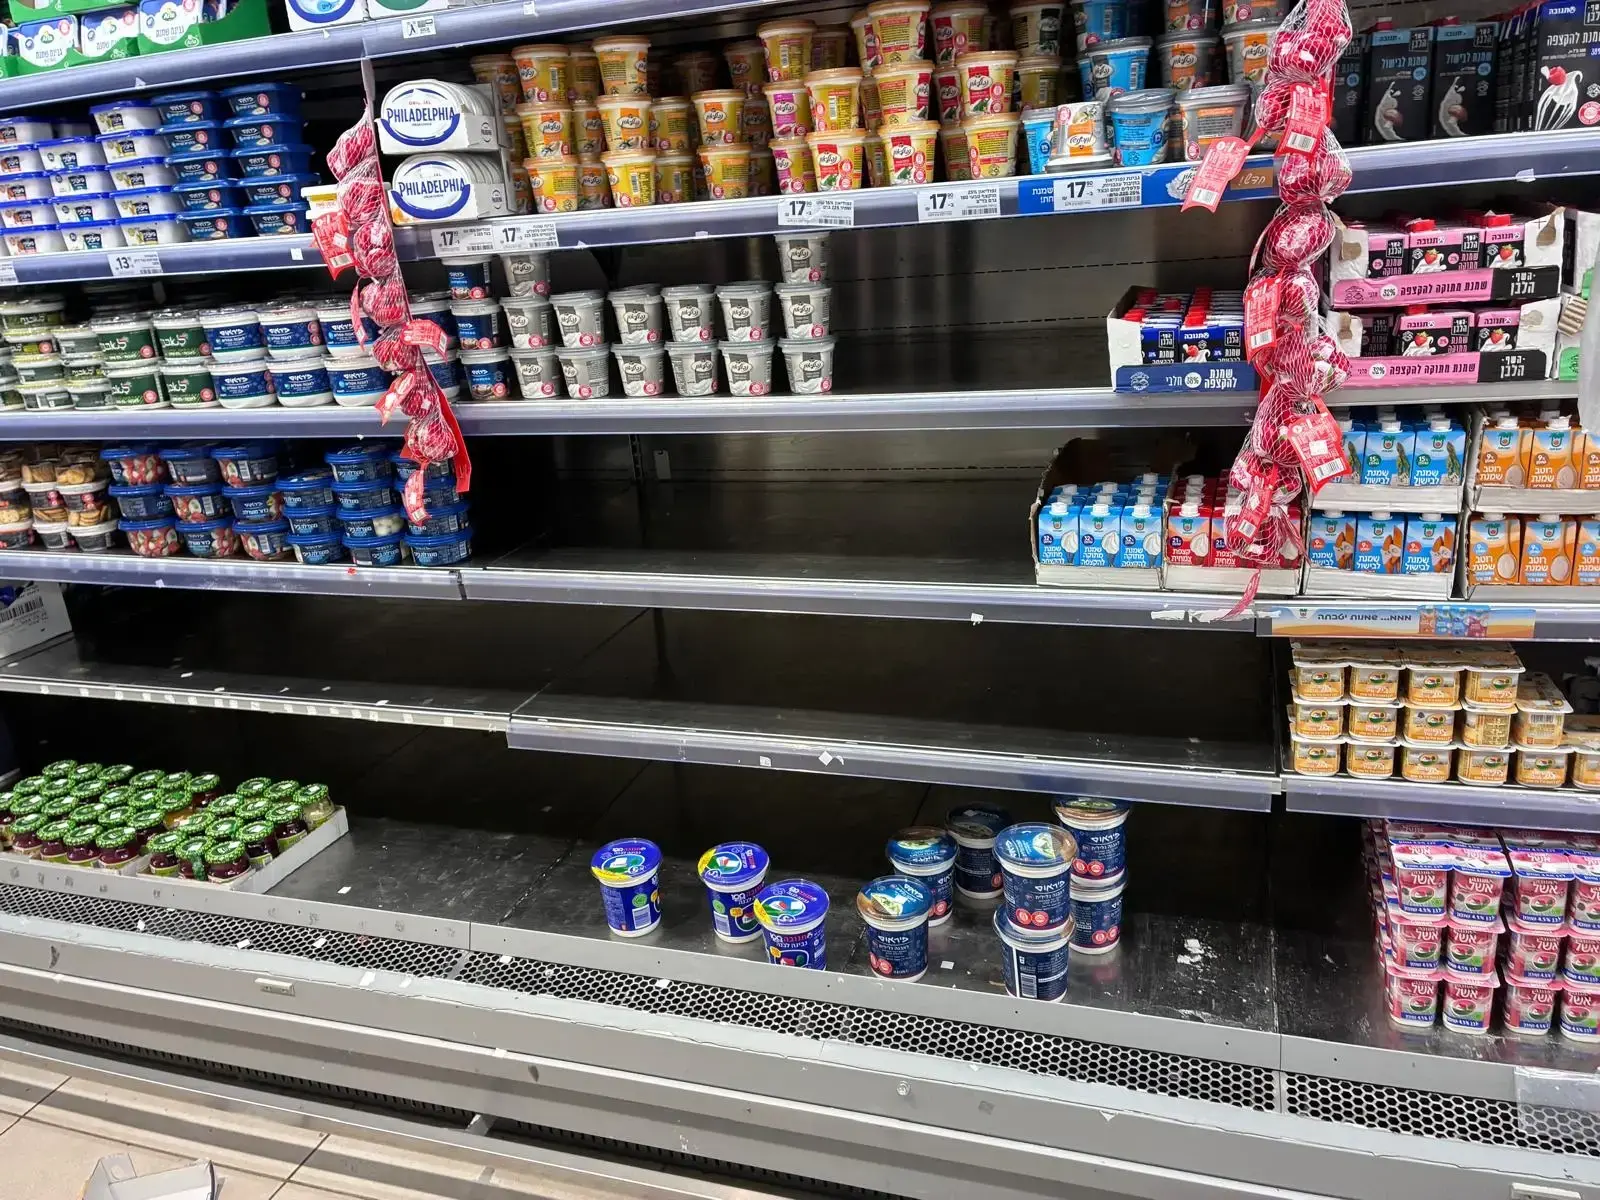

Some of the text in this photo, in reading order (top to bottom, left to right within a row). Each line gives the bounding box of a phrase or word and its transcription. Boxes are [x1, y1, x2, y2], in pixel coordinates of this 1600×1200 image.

[387, 107, 455, 122] PHILADELPHIA
[398, 178, 464, 196] PHILADELPHIA
[1067, 181, 1087, 199] 17
[930, 193, 947, 209] 17
[789, 200, 806, 215] 17
[441, 231, 454, 245] 17
[502, 228, 516, 242] 17
[116, 257, 129, 269] 13
[1401, 286, 1432, 296] להקצפה
[1435, 284, 1462, 293] מתוקה
[1465, 281, 1487, 290] שמנת
[1511, 282, 1535, 296] הלבן
[1210, 369, 1233, 379] שמנת
[1390, 366, 1421, 376] להקצפה
[1424, 366, 1449, 375] מתוקה
[1452, 363, 1476, 373] שמנת
[1500, 365, 1525, 379] הלבן
[1165, 376, 1183, 387] חלבי
[1204, 377, 1238, 389] להקצפה
[1366, 470, 1389, 478] שמנת
[1416, 470, 1439, 478] שמנת
[1480, 473, 1503, 481] שמנת
[1414, 477, 1439, 485] לבישול
[1408, 556, 1430, 564] שמנת
[1475, 555, 1493, 563] רוטב
[1035, 880, 1066, 891] פיראוס
[1412, 874, 1435, 885] אשל
[1470, 880, 1493, 893] אשל
[1534, 882, 1558, 894] אשל
[878, 935, 909, 943] פיראוס
[1416, 929, 1438, 940] אשל
[1454, 929, 1477, 943] אשל
[1536, 938, 1558, 950] אשל
[1576, 939, 1600, 952] אשל
[1411, 982, 1434, 994] אשל
[1455, 985, 1478, 997] אשל
[1532, 989, 1553, 1001] אשל
[1569, 993, 1592, 1005] אשל
